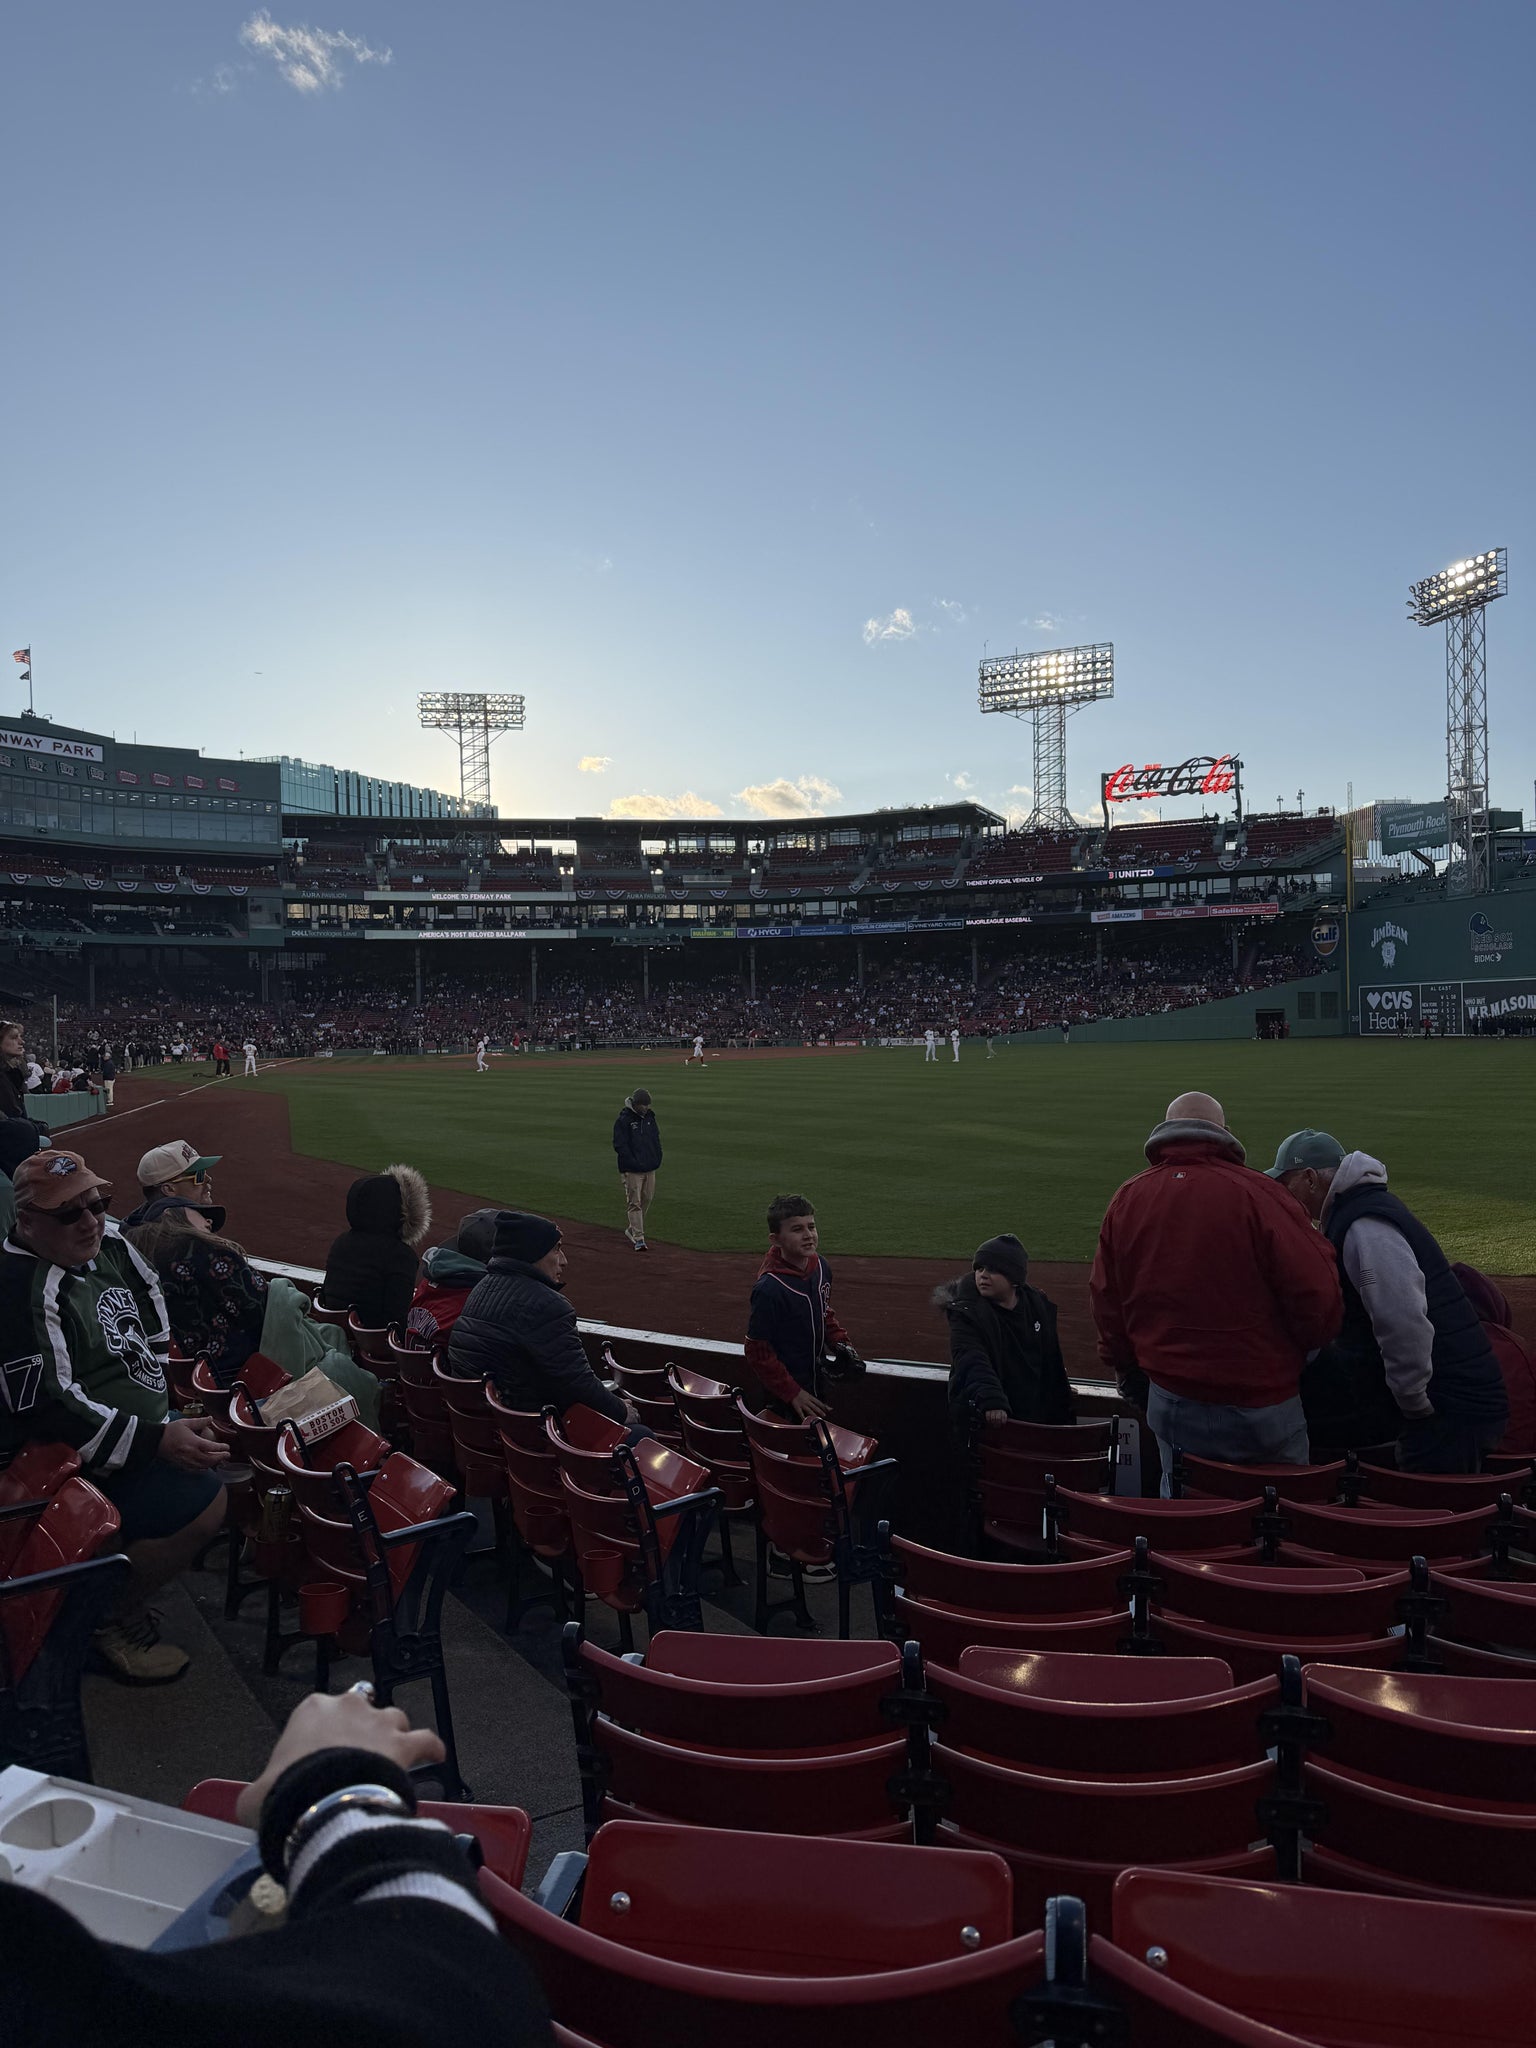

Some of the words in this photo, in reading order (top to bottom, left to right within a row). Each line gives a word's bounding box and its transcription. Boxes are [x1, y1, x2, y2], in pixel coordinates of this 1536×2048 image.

[53, 742, 95, 758] PARK
[1388, 820, 1425, 837] Plymouth
[1425, 813, 1447, 829] Rock
[1119, 869, 1155, 879] UNITED
[1005, 916, 1032, 924] BASEBALL
[418, 930, 450, 938] AMERICA'S
[451, 930, 467, 938] MOST
[468, 930, 494, 938] BELOVED
[496, 930, 527, 938] BALLPARK
[758, 928, 781, 936] HYCU
[1313, 926, 1337, 941] Gulf
[1474, 954, 1495, 963] BIDMC
[1381, 990, 1413, 1010] CVS
[309, 1406, 344, 1428] BOSTON
[312, 1425, 328, 1437] RED
[331, 1414, 347, 1428] SOX
[357, 1510, 368, 1523] E
